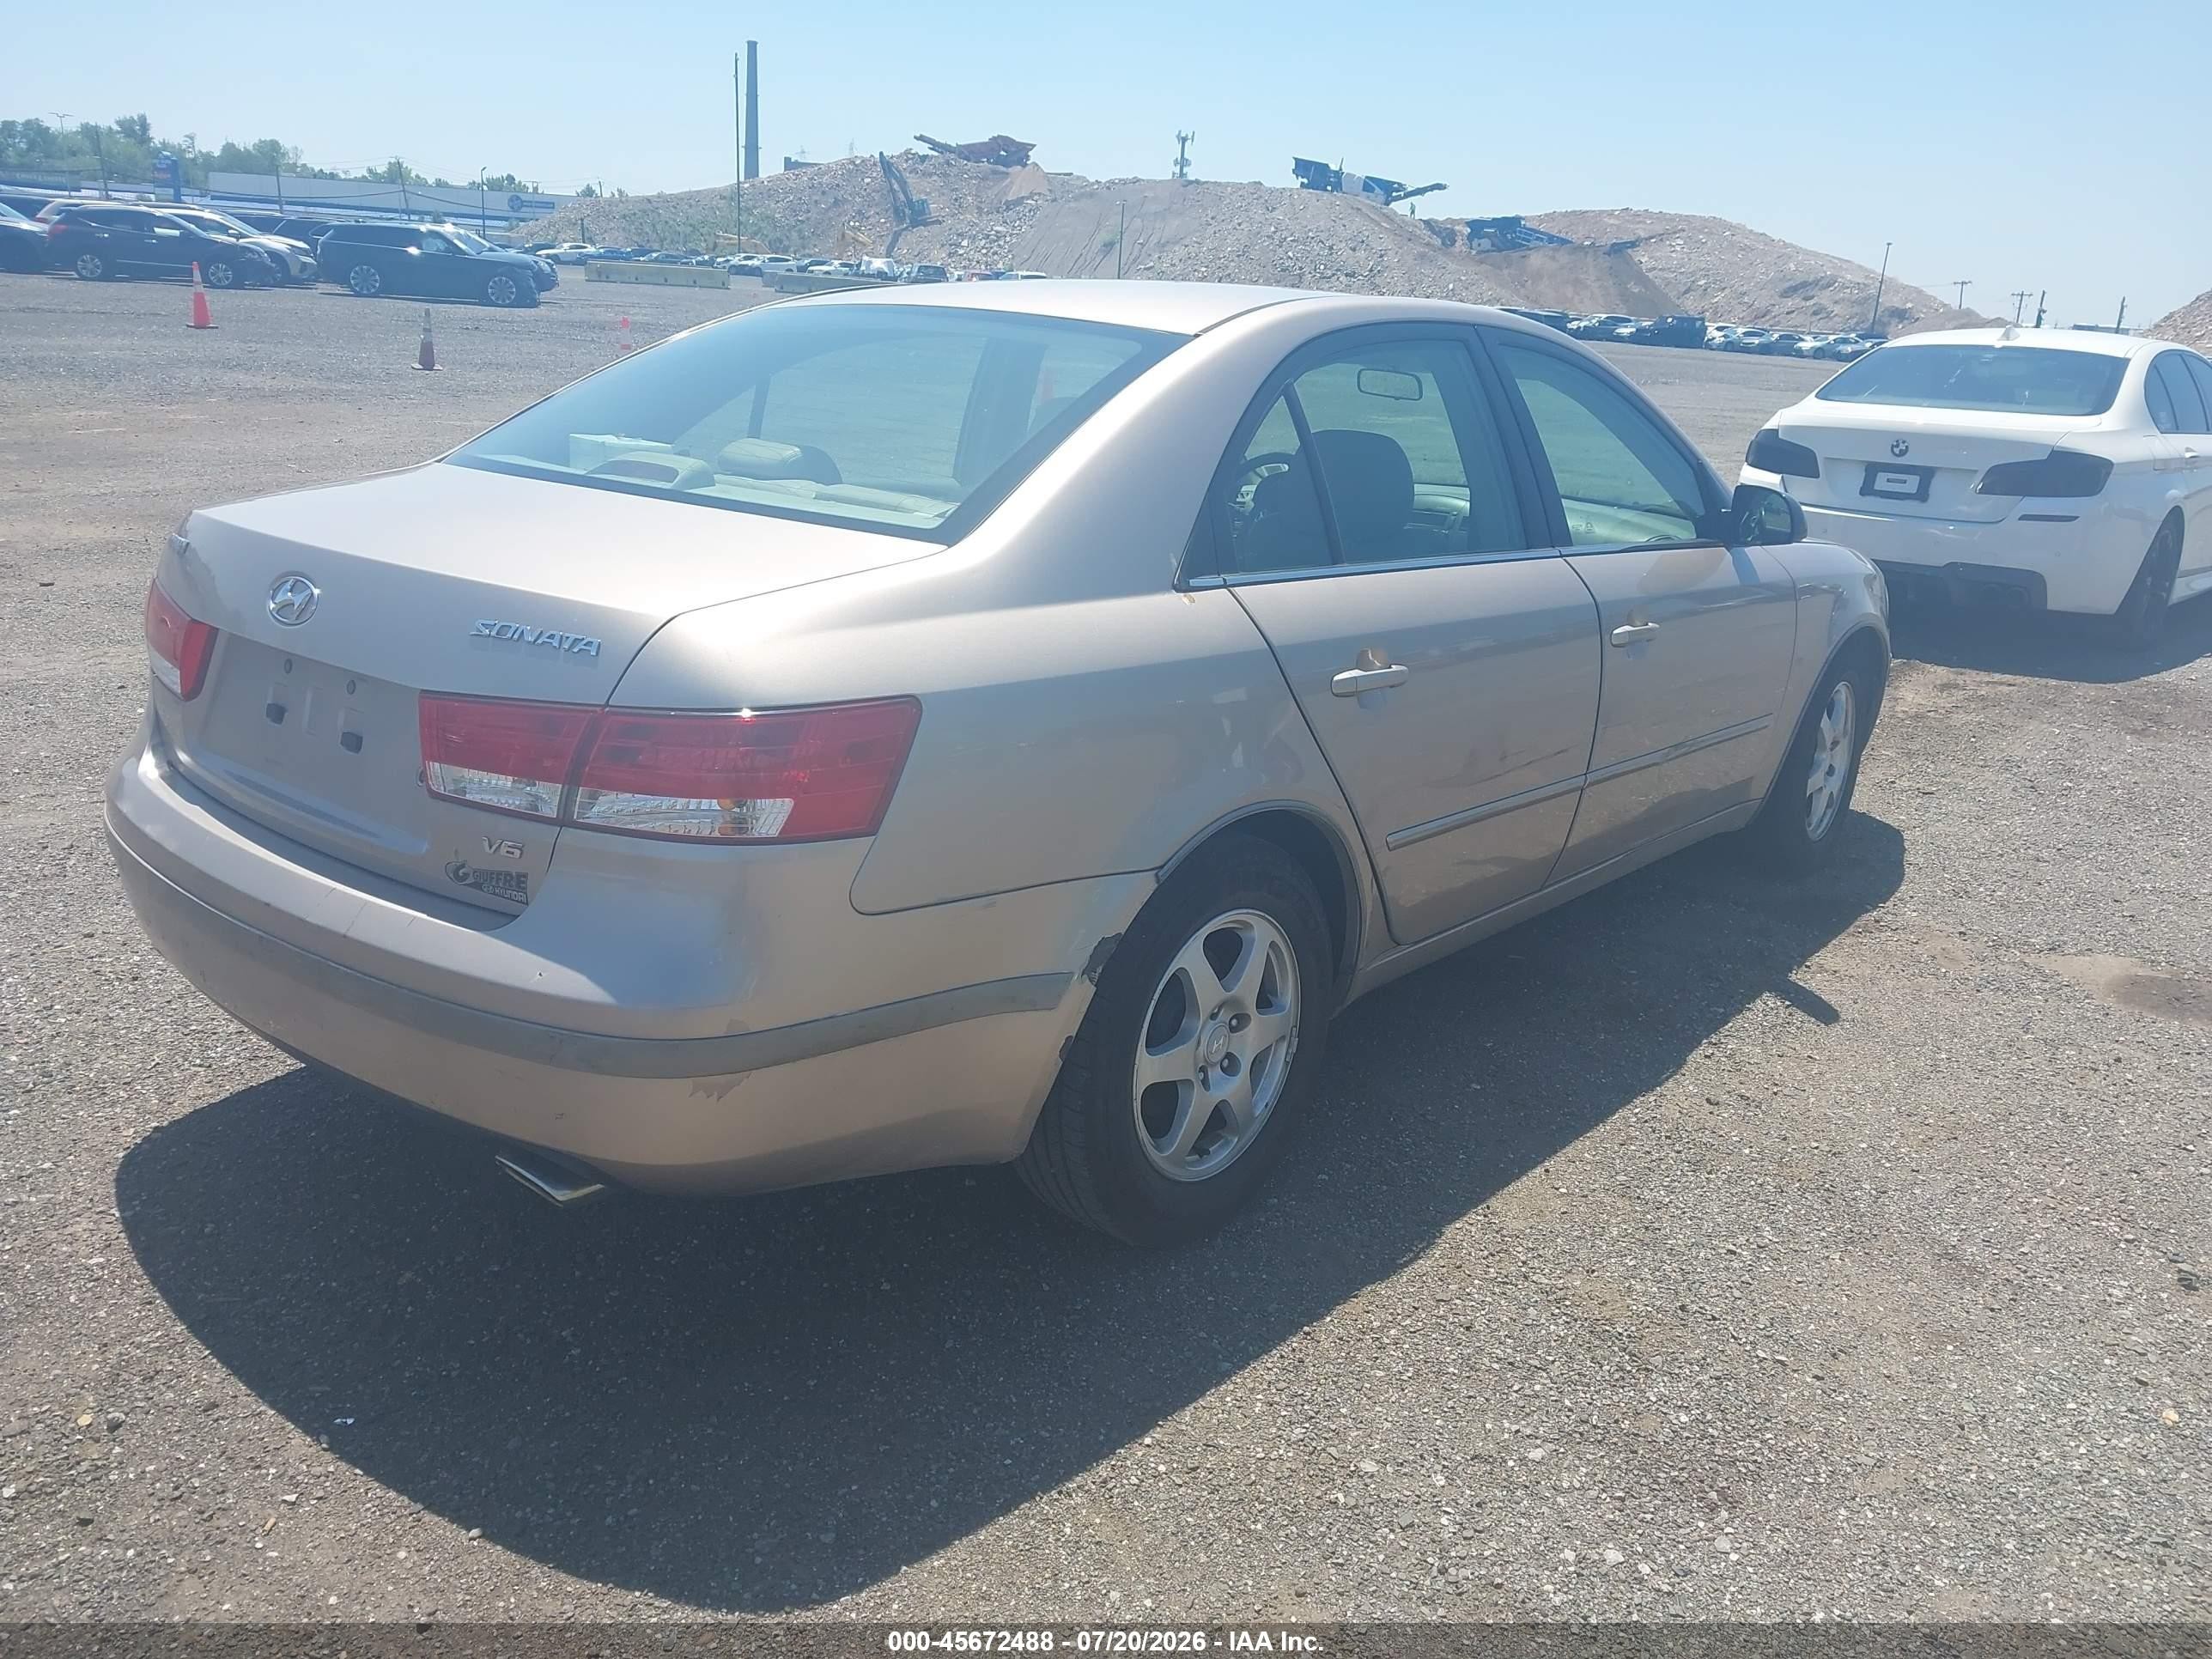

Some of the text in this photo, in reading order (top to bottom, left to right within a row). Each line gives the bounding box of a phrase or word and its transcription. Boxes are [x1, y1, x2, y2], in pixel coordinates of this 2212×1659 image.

[470, 618, 601, 656] SONATA
[482, 836, 523, 860] V6
[495, 886, 527, 903] HYUNDAI
